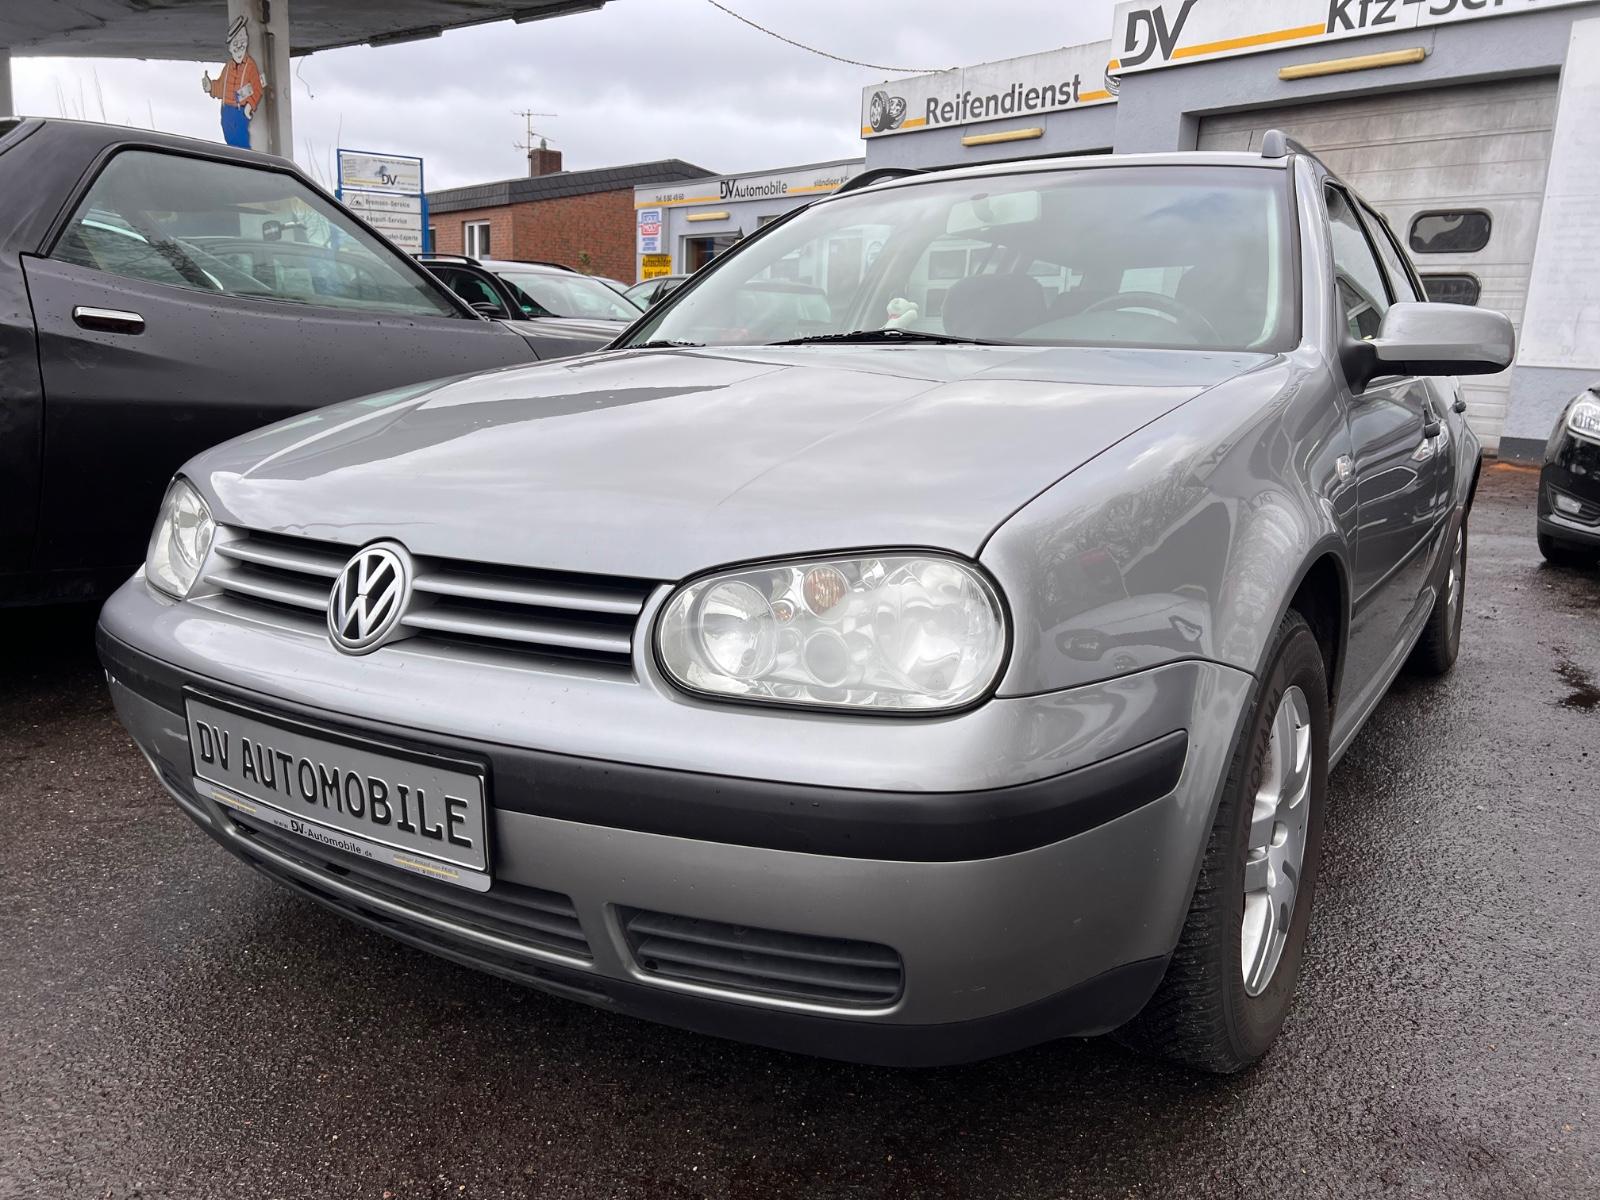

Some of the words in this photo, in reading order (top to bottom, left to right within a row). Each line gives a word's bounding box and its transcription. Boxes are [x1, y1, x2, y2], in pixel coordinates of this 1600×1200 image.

[1119, 0, 1197, 68] DV
[925, 73, 1081, 126] Reifendienst
[381, 174, 397, 186] DV
[720, 179, 736, 199] DV
[734, 180, 788, 198] Automobile
[196, 720, 229, 770] DV
[241, 737, 473, 848] AUTOMOBILE
